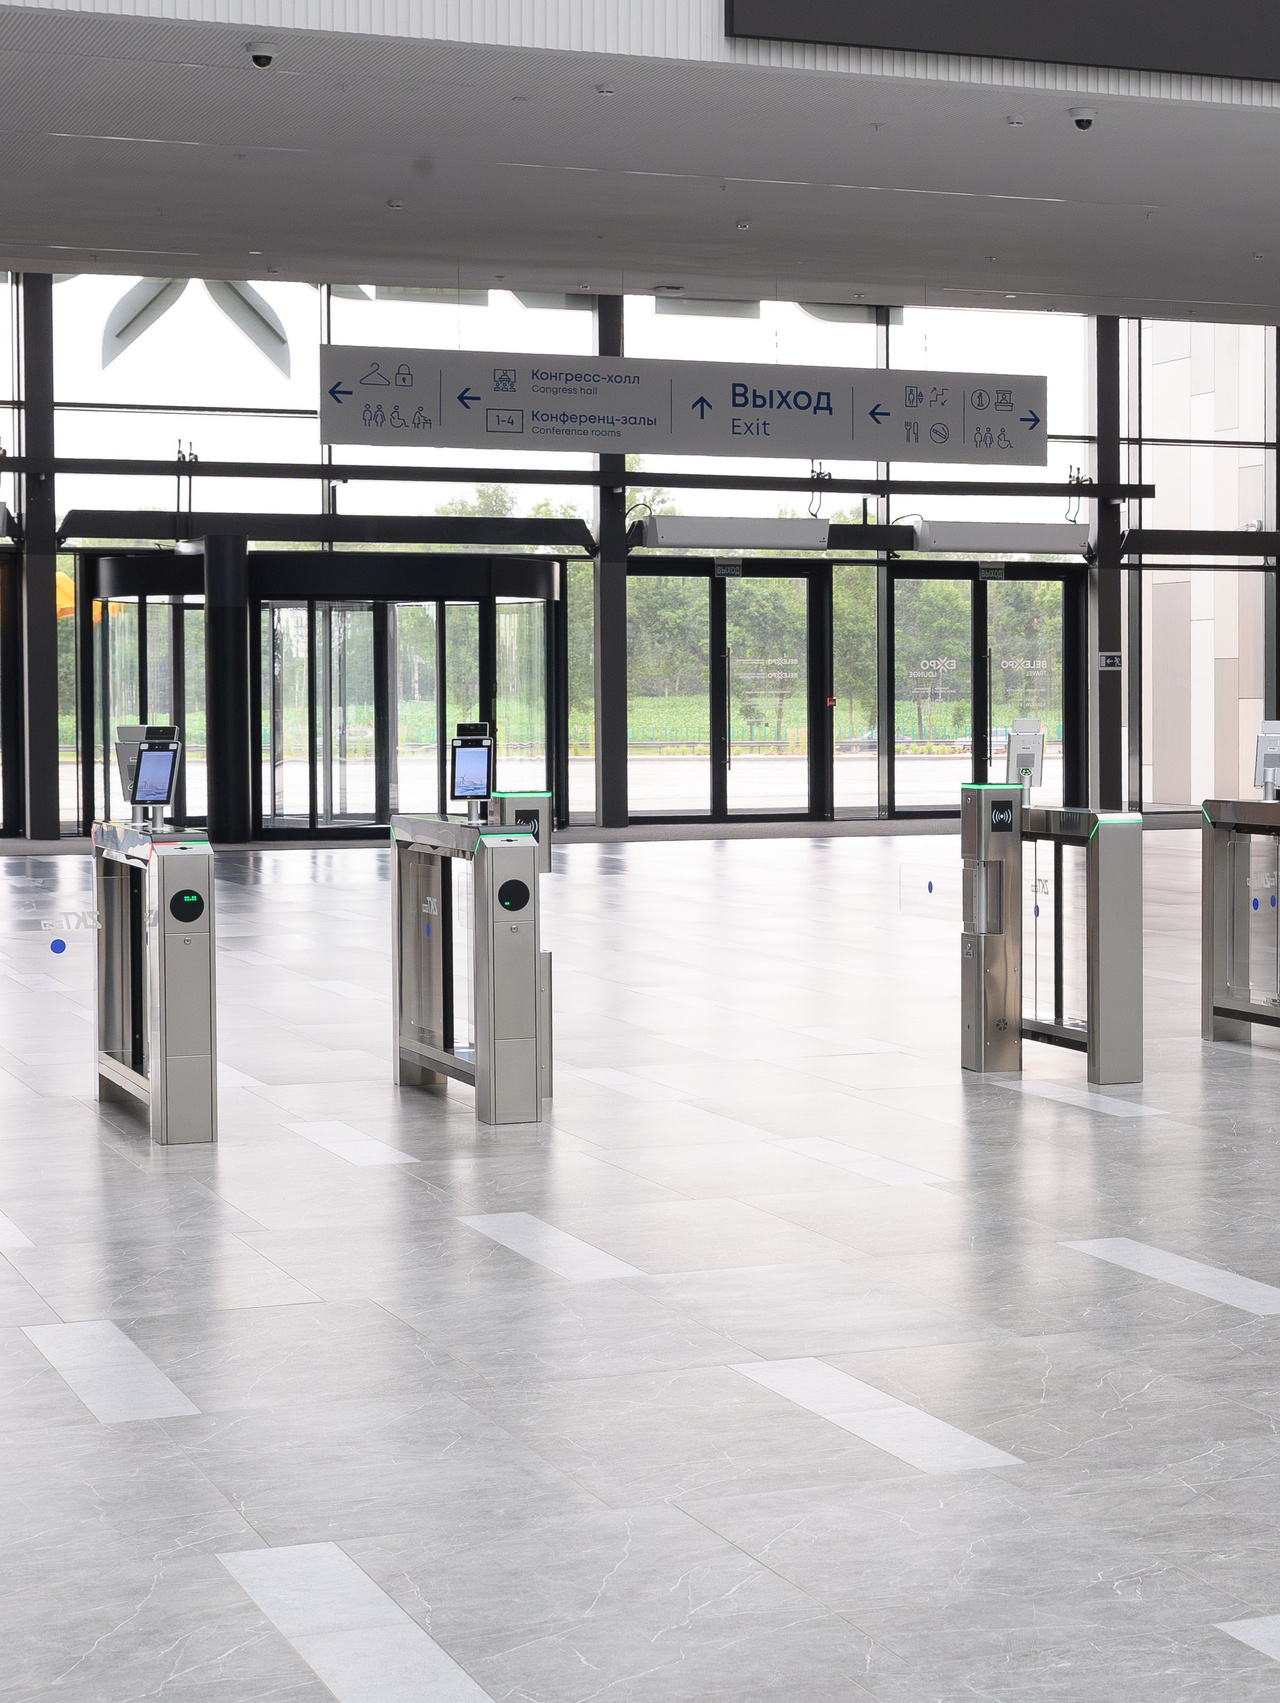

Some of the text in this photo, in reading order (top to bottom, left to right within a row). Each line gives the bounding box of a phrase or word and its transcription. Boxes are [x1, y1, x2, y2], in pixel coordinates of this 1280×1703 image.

[531, 368, 640, 385] Конгресс-холл
[531, 384, 598, 396] Congress hall
[732, 382, 833, 415] Выход
[496, 414, 515, 426] 1-4
[531, 410, 657, 426] Конференц-залы
[531, 425, 622, 437] Conference rooms
[732, 418, 770, 436] Exit
